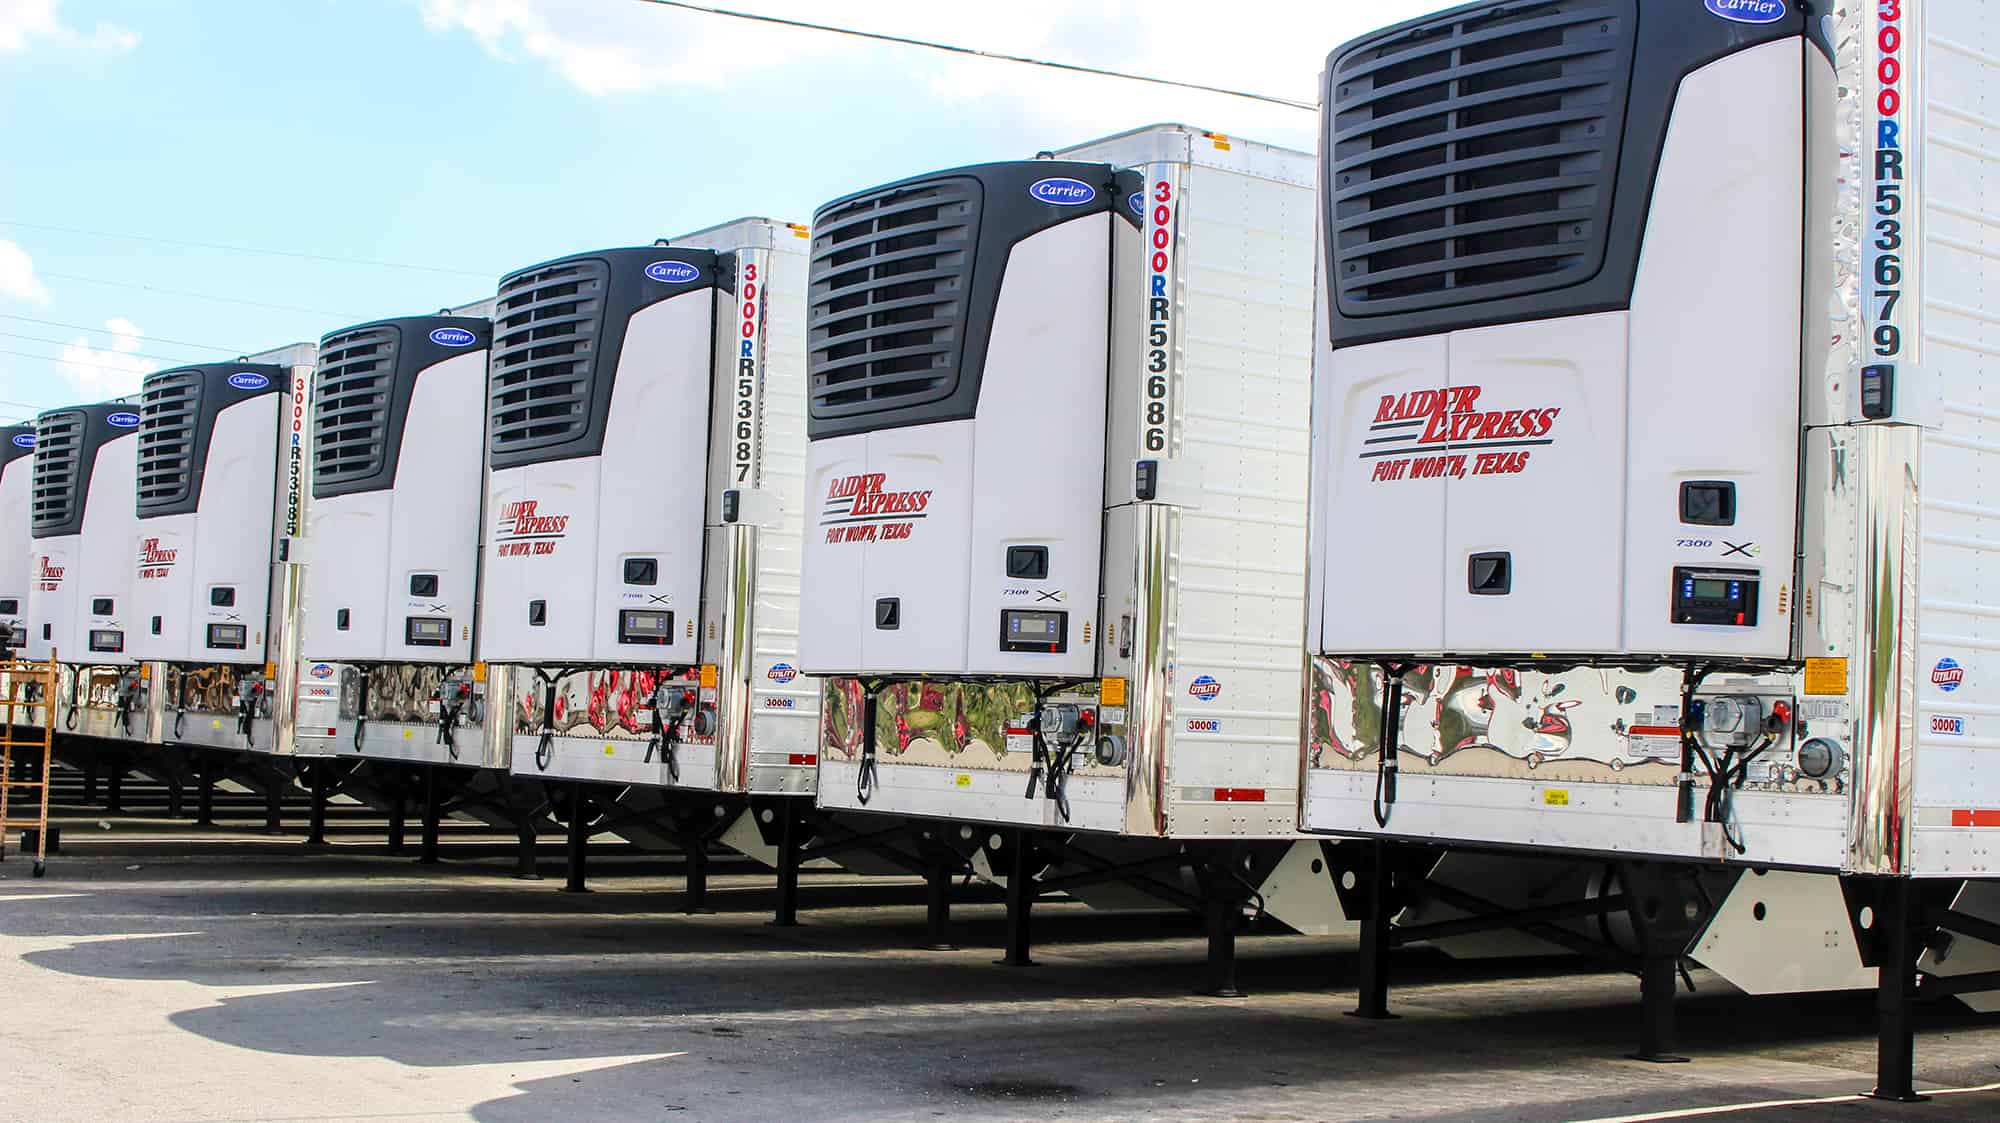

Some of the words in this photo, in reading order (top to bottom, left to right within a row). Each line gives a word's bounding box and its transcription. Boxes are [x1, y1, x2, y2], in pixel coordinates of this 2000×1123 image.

[1038, 183, 1087, 197] Carrier
[652, 266, 692, 277] Carrier
[435, 331, 470, 341] Carrier
[1373, 385, 1481, 424] RAIDER
[1418, 398, 1562, 443] EXPRESS
[1372, 459, 1410, 482] FORT
[1472, 451, 1530, 475] TEXAS
[849, 485, 933, 516] EXPRESS
[1677, 540, 1712, 548] 7300
[1933, 670, 1962, 682] UTILITY
[1189, 720, 1218, 731] 3000R
[1932, 718, 1961, 733] 3000R
